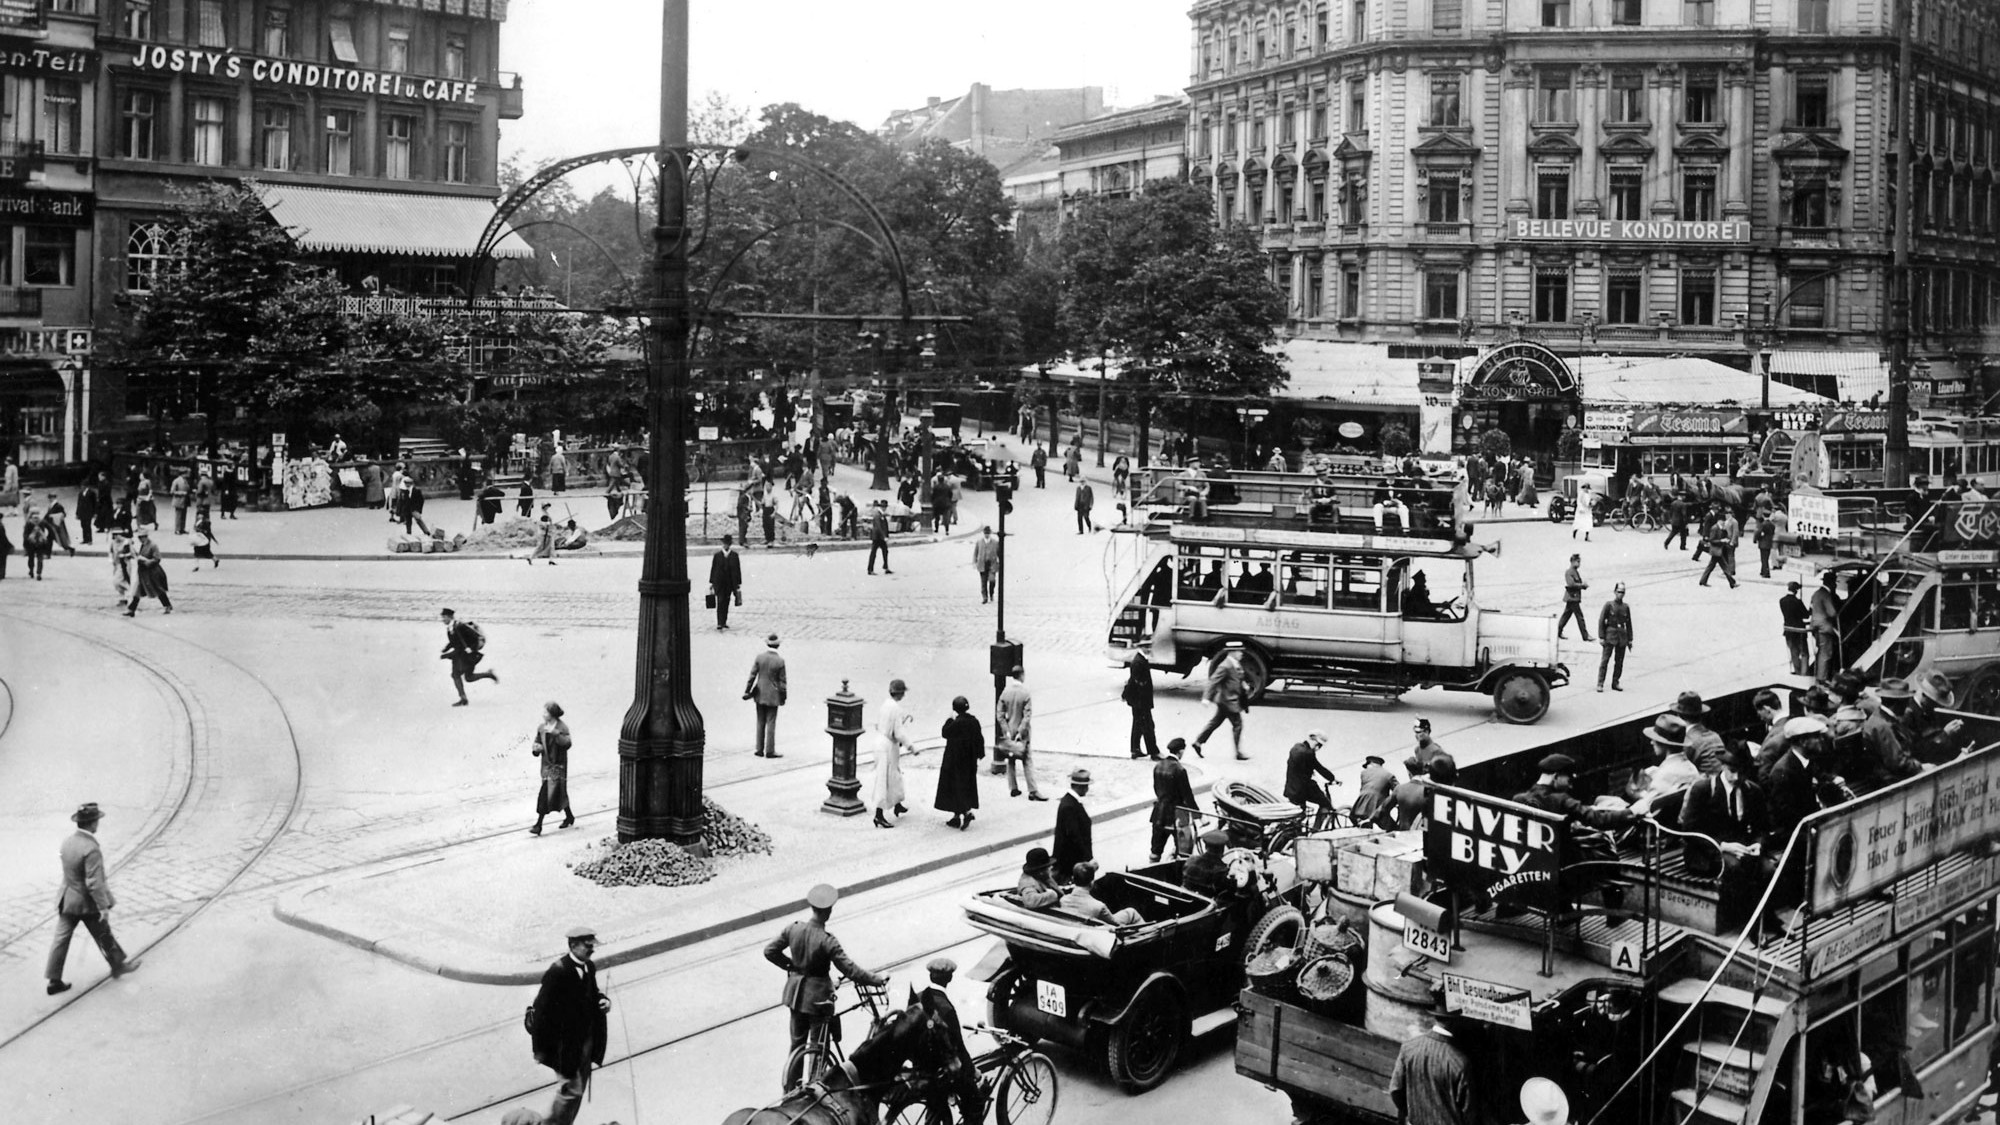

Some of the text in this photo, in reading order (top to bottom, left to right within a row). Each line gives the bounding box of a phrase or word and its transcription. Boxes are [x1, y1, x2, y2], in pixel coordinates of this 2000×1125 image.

[252, 59, 401, 96] CONDITOREI
[423, 76, 478, 103] CAFÉ
[1516, 221, 1741, 240] BELLEVUE KONDITOREI
[1482, 386, 1557, 397] KONDITOREI
[1774, 412, 1815, 422] ENVER
[1844, 414, 1889, 431] Tesm
[1954, 503, 2000, 540] Te
[1433, 793, 1555, 853] ENVER
[1868, 820, 1898, 845] Feuer
[1451, 831, 1531, 875] BEY
[1486, 870, 1551, 898] ZIGARETTEN
[1406, 927, 1448, 956] 12843
[1616, 946, 1633, 969] A
